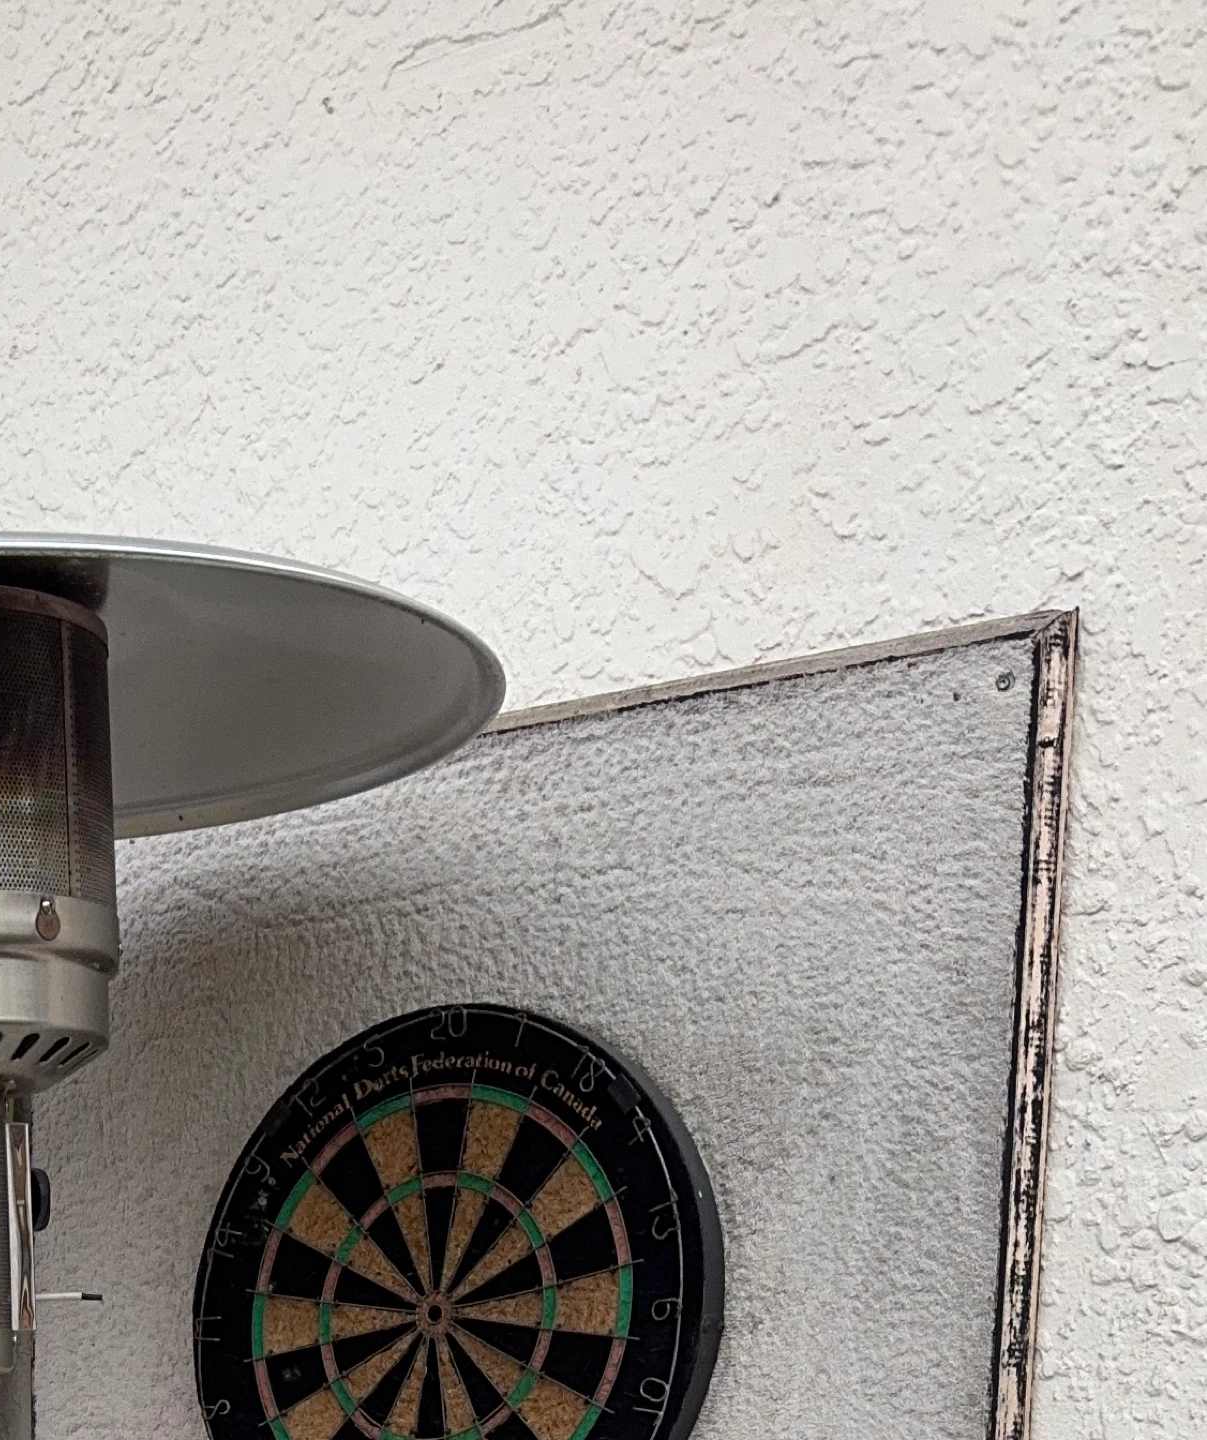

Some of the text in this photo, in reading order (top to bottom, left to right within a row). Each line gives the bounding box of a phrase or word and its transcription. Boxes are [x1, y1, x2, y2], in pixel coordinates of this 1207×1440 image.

[427, 1005, 467, 1041] 20
[363, 1033, 385, 1068] 5
[279, 1050, 603, 1169] National Darts Federation of Canada
[194, 1315, 223, 1343] 11
[632, 1376, 671, 1421] 10
